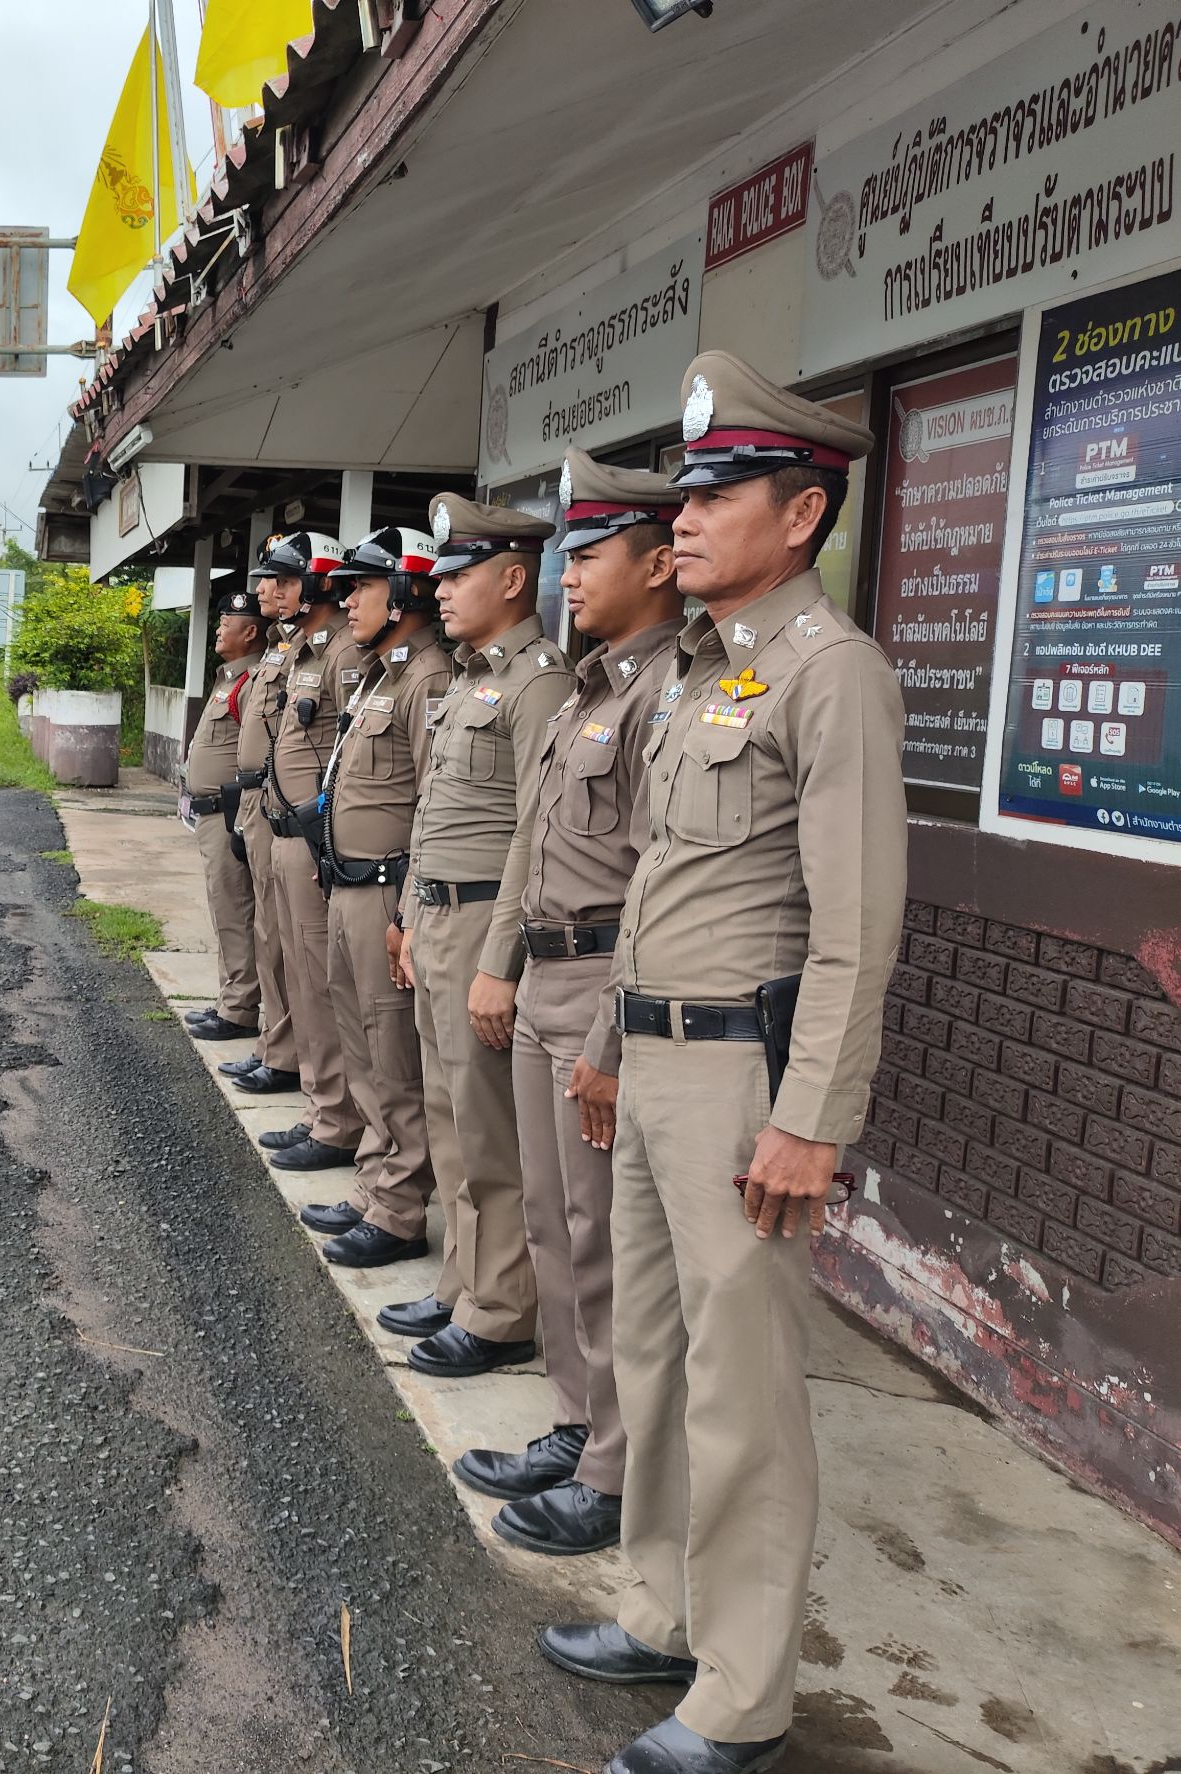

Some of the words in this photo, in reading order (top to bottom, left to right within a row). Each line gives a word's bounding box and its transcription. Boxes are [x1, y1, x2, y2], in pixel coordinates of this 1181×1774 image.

[857, 18, 1181, 259] ศูนย์ปฏิบัติการจราจรและอำนวยค
[710, 212, 735, 258] RAKA
[742, 176, 777, 243] POLICE
[783, 156, 806, 220] BOX
[883, 154, 1175, 321] การเปรียบเทียบปรับตามระบบ
[508, 259, 691, 397] สถานีตำรวจภูธรกระสัง
[1052, 330, 1070, 363] 2
[1074, 307, 1176, 357] ช่องทาง
[542, 380, 631, 442] ส่วนย่อยระกา
[927, 410, 965, 441] VISION
[1086, 437, 1128, 463] PTM
[1049, 495, 1074, 509] Police
[1076, 491, 1103, 505] Ticket
[1105, 482, 1174, 501] Management
[417, 542, 438, 555] 611
[900, 516, 994, 556] บังคับใช้กฎหมาย
[323, 545, 344, 556] 611
[901, 564, 979, 598] อย่างเป็นธรรม
[1150, 564, 1175, 577] PTM
[892, 609, 988, 642] นำสมัยเทคโนโลยี
[1023, 644, 1029, 656] 2
[1086, 642, 1106, 656] ขับดี
[1107, 644, 1137, 656] KHUB
[1139, 644, 1162, 656] DEE
[905, 709, 951, 729] .สมประสงค์
[1109, 727, 1120, 737] SOS
[970, 745, 976, 759] 3
[1100, 783, 1111, 791] App
[1146, 785, 1167, 796] Google
[1168, 787, 1181, 798] Play
